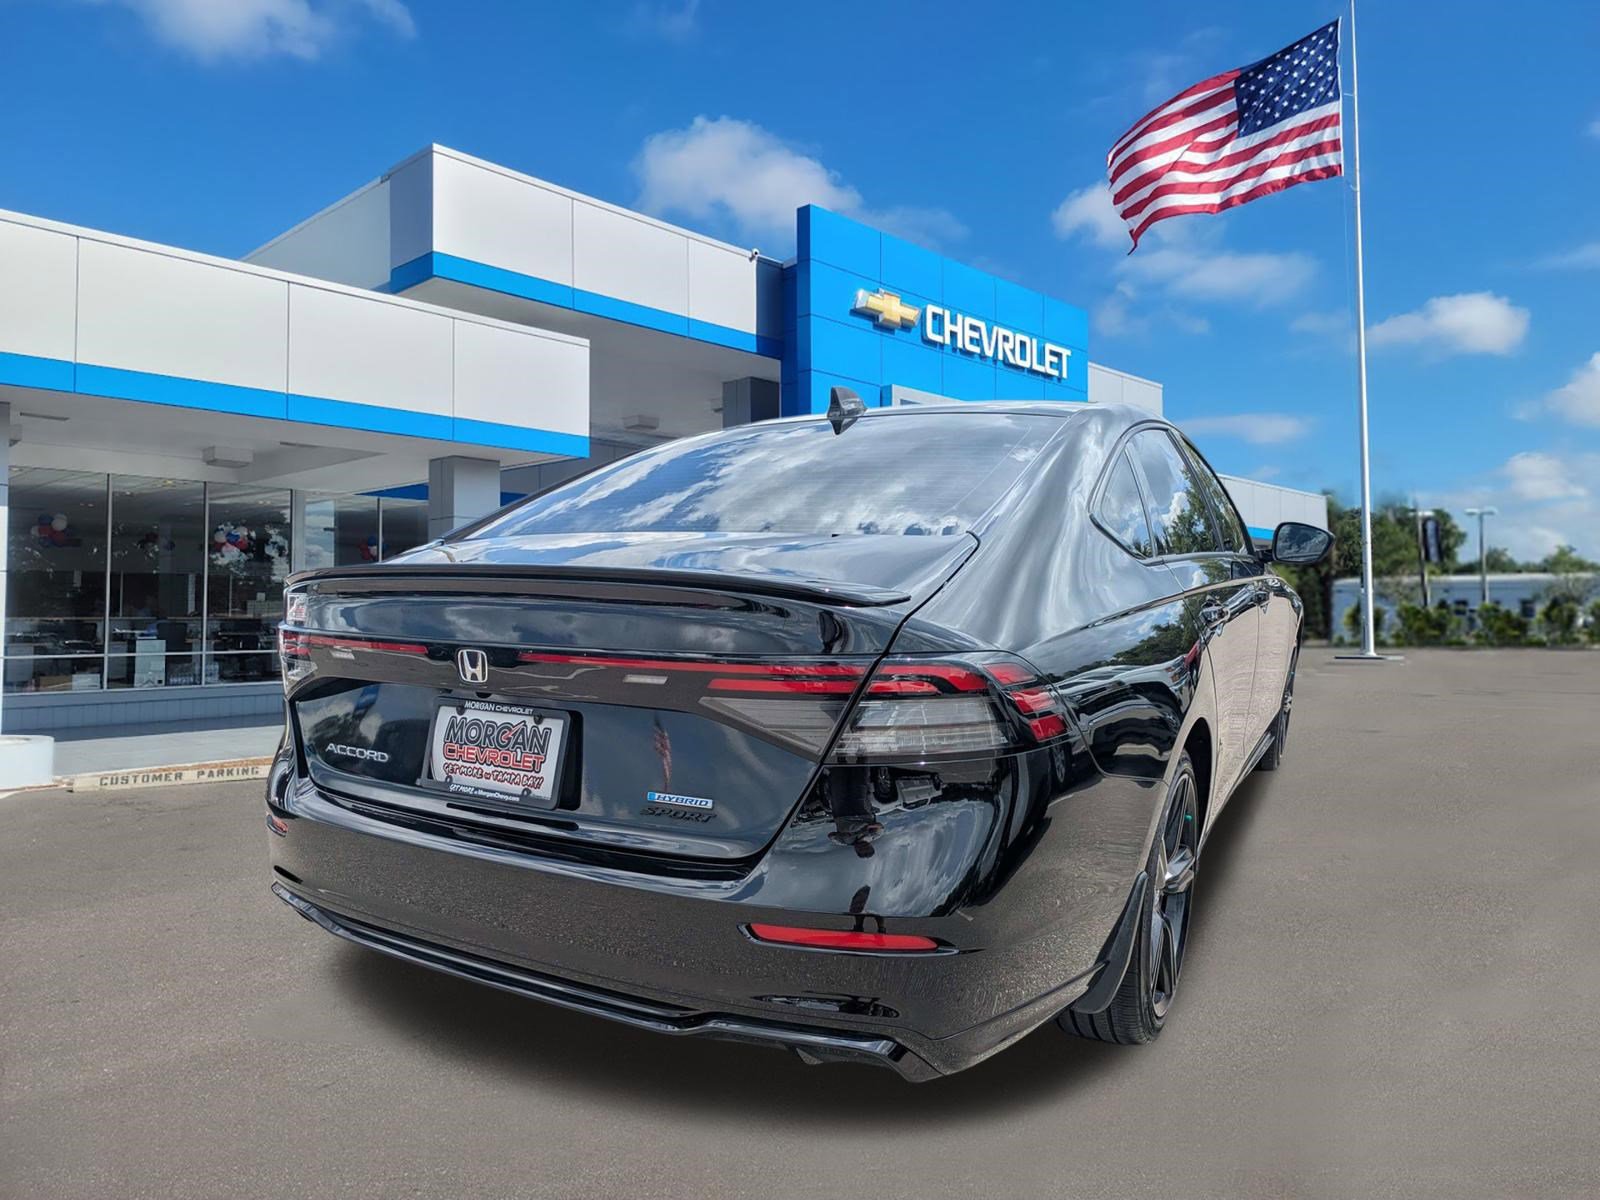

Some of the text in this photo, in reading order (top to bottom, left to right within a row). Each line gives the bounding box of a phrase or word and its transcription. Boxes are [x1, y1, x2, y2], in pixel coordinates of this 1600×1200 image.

[925, 303, 1072, 379] CHEVROLET
[464, 700, 533, 715] MORGAN CHEVROLET
[444, 715, 552, 756] MORGAN
[325, 743, 389, 763] ACCORD
[443, 742, 546, 773] CHEVROLET
[99, 766, 259, 787] CUSTOMER PARKING
[443, 762, 459, 775] GET
[459, 765, 484, 779] MORE
[491, 769, 521, 786] TAMPA
[459, 785, 474, 794] MORE
[656, 794, 709, 807] HYBRID
[641, 806, 717, 823] SPORT
